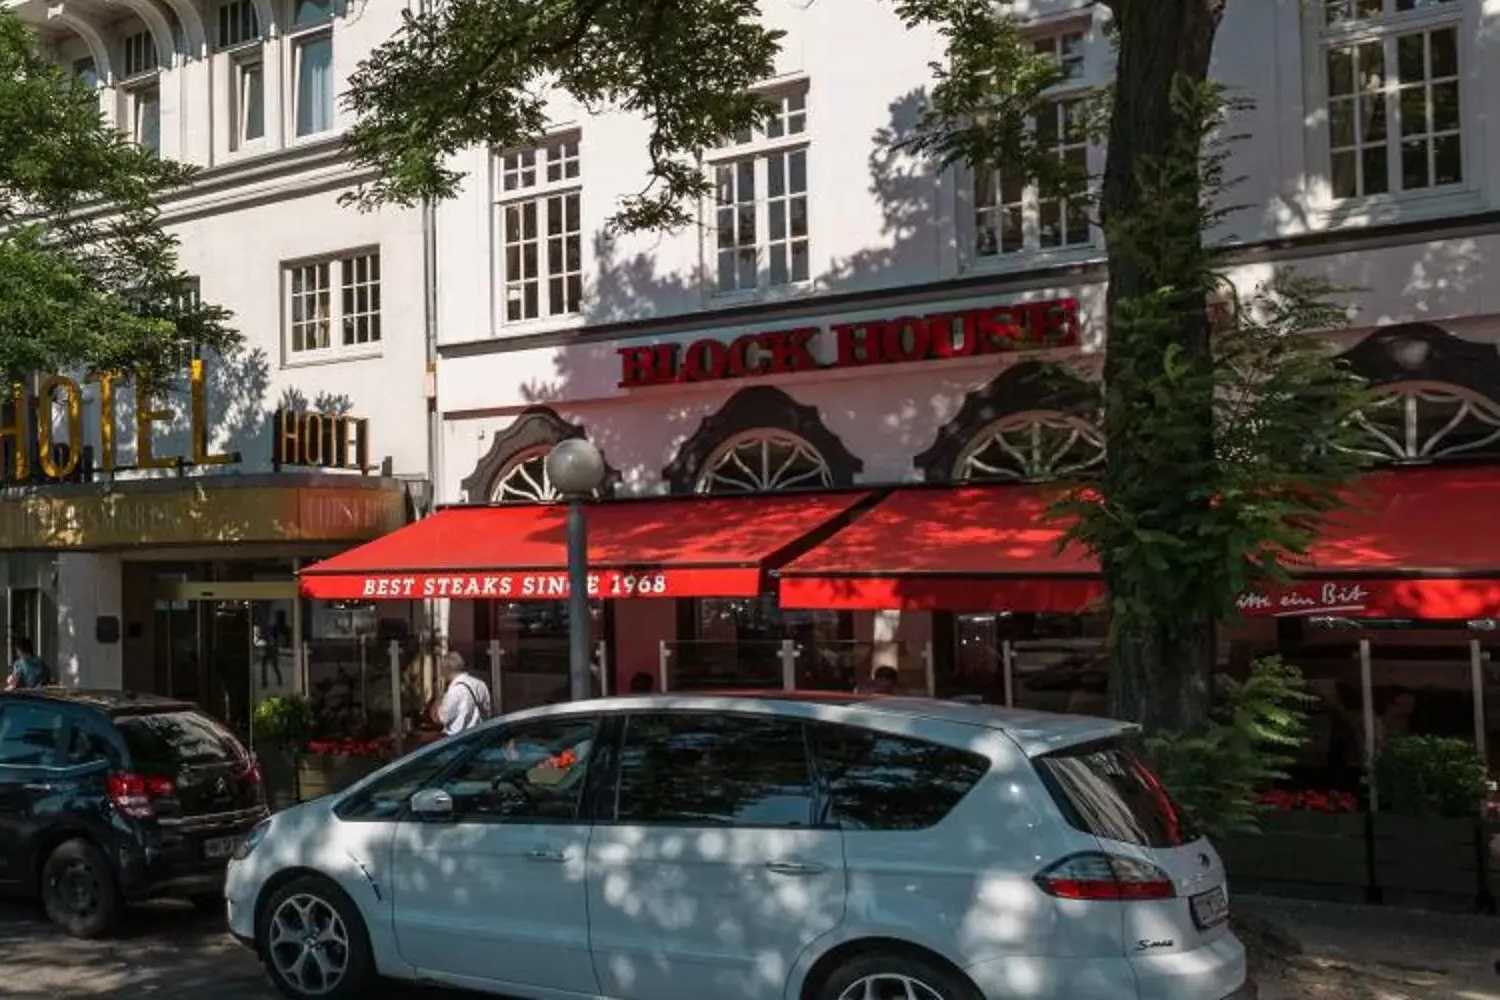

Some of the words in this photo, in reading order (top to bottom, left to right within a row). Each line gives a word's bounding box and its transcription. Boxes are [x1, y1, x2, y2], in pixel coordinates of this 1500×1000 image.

[617, 326, 821, 388] BLOCK
[830, 296, 1077, 365] HOUSE
[277, 410, 380, 471] HOTEL
[362, 578, 415, 597] BEST
[423, 576, 513, 596] STEAKS
[522, 575, 600, 595] SINE
[611, 575, 667, 594] 1968
[1321, 582, 1370, 605] Bit
